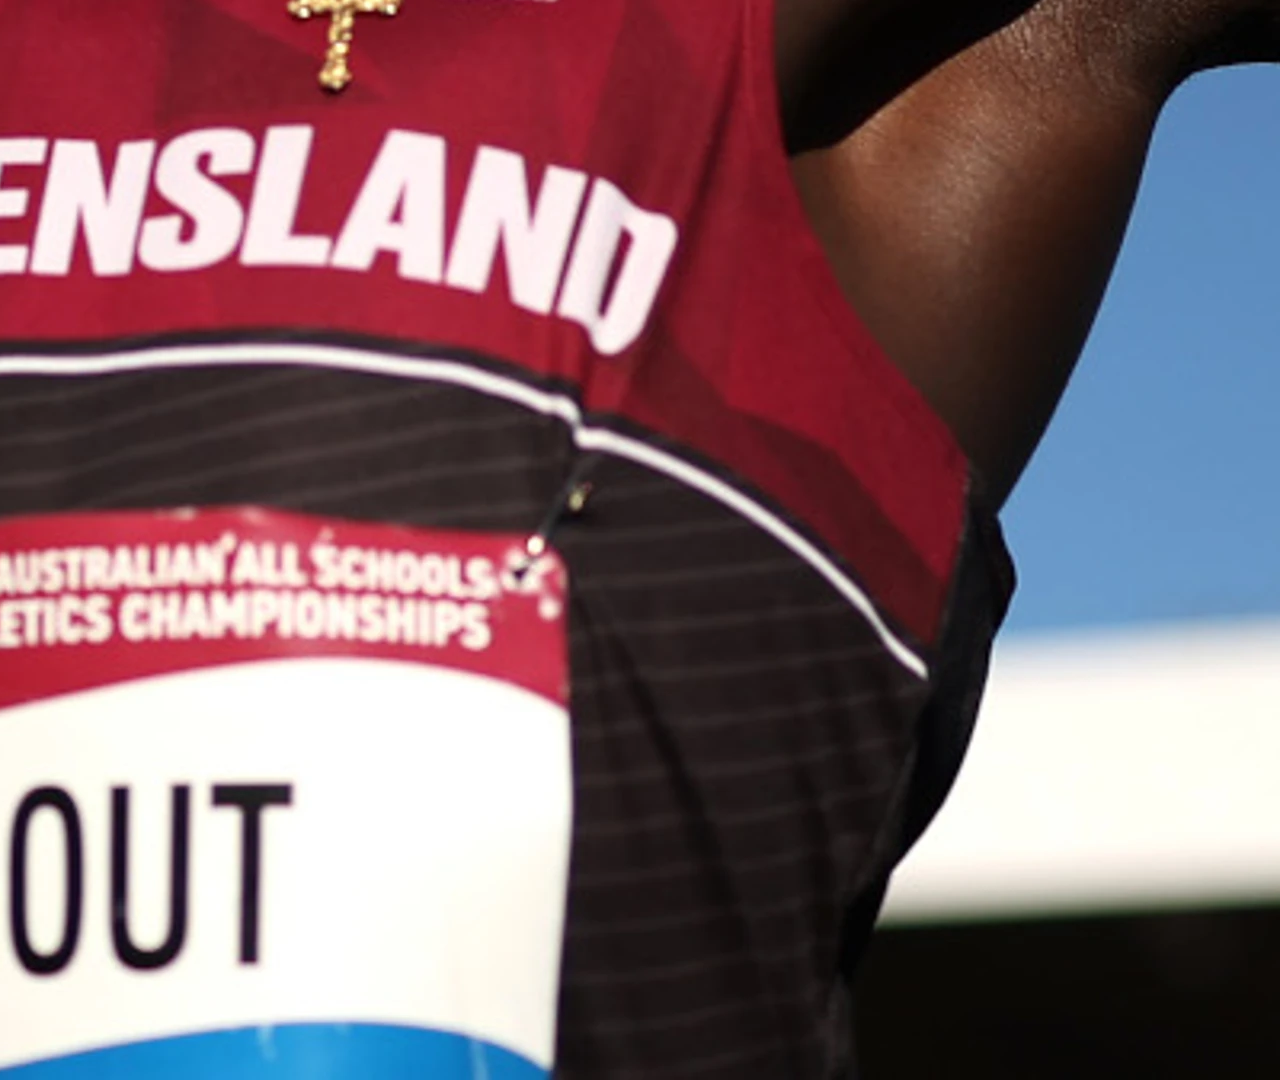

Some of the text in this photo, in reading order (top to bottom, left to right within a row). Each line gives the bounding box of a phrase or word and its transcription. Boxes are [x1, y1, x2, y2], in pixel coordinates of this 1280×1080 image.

[230, 540, 309, 587] ALL
[310, 544, 502, 601] SCHOOLS
[119, 590, 492, 651] CHAMPIONSHIPS
